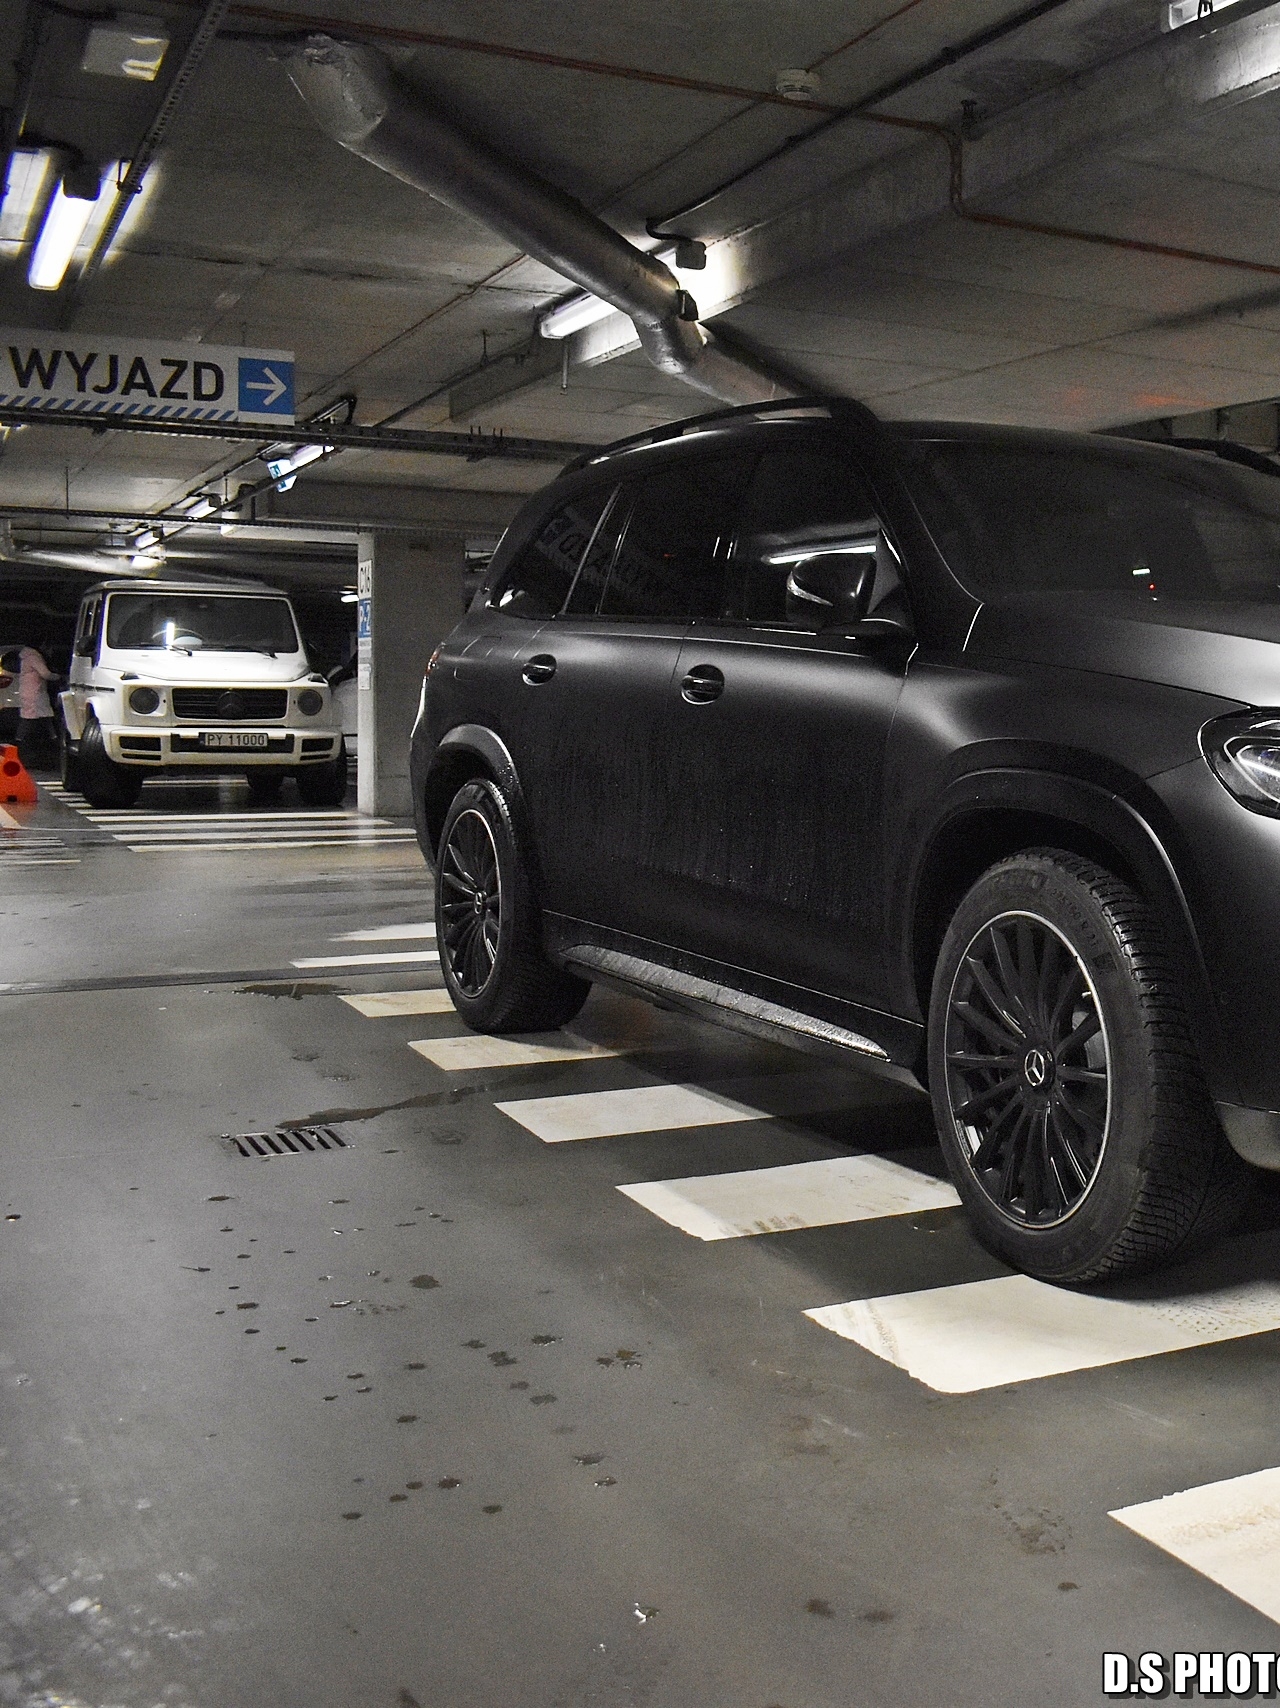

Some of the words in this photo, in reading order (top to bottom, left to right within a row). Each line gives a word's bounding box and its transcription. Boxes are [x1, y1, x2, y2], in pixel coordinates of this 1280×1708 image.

[9, 346, 225, 402] WYJAZD
[207, 734, 223, 746] PY
[228, 734, 265, 746] 11000
